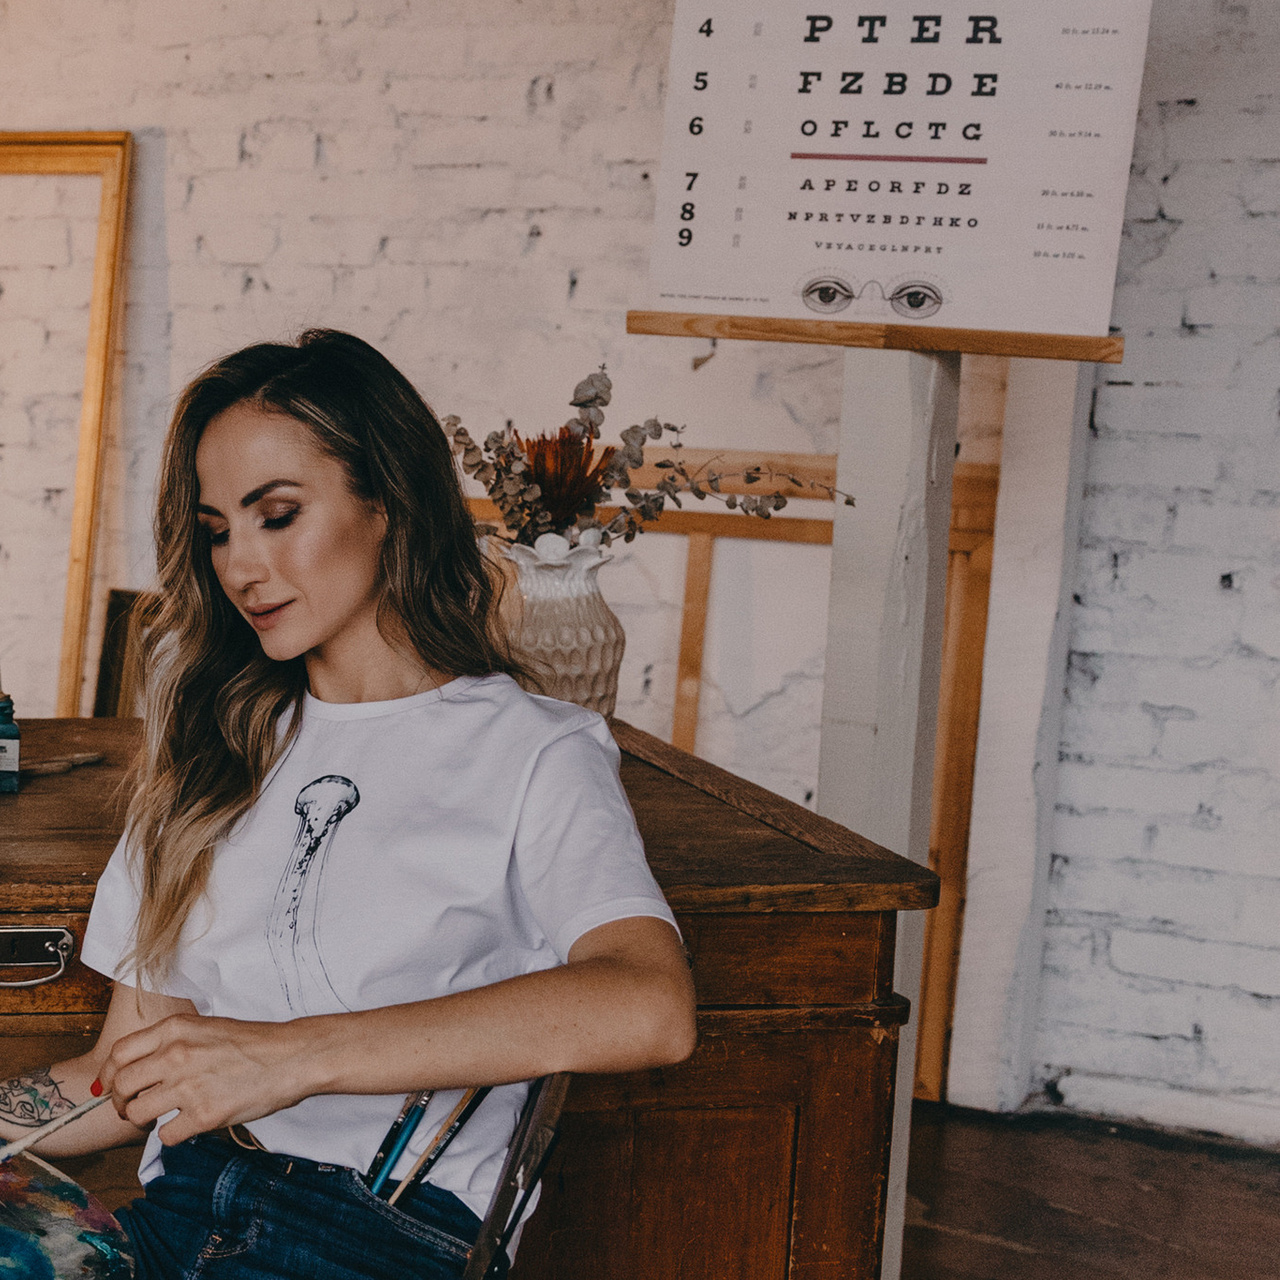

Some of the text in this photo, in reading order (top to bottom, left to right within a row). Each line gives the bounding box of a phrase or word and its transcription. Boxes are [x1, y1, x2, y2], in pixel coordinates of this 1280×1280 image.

[698, 18, 714, 38] 4
[693, 71, 708, 91] 5
[688, 116, 704, 136] 6
[685, 172, 699, 191] 7
[680, 202, 695, 222] 8
[678, 227, 693, 247] 9
